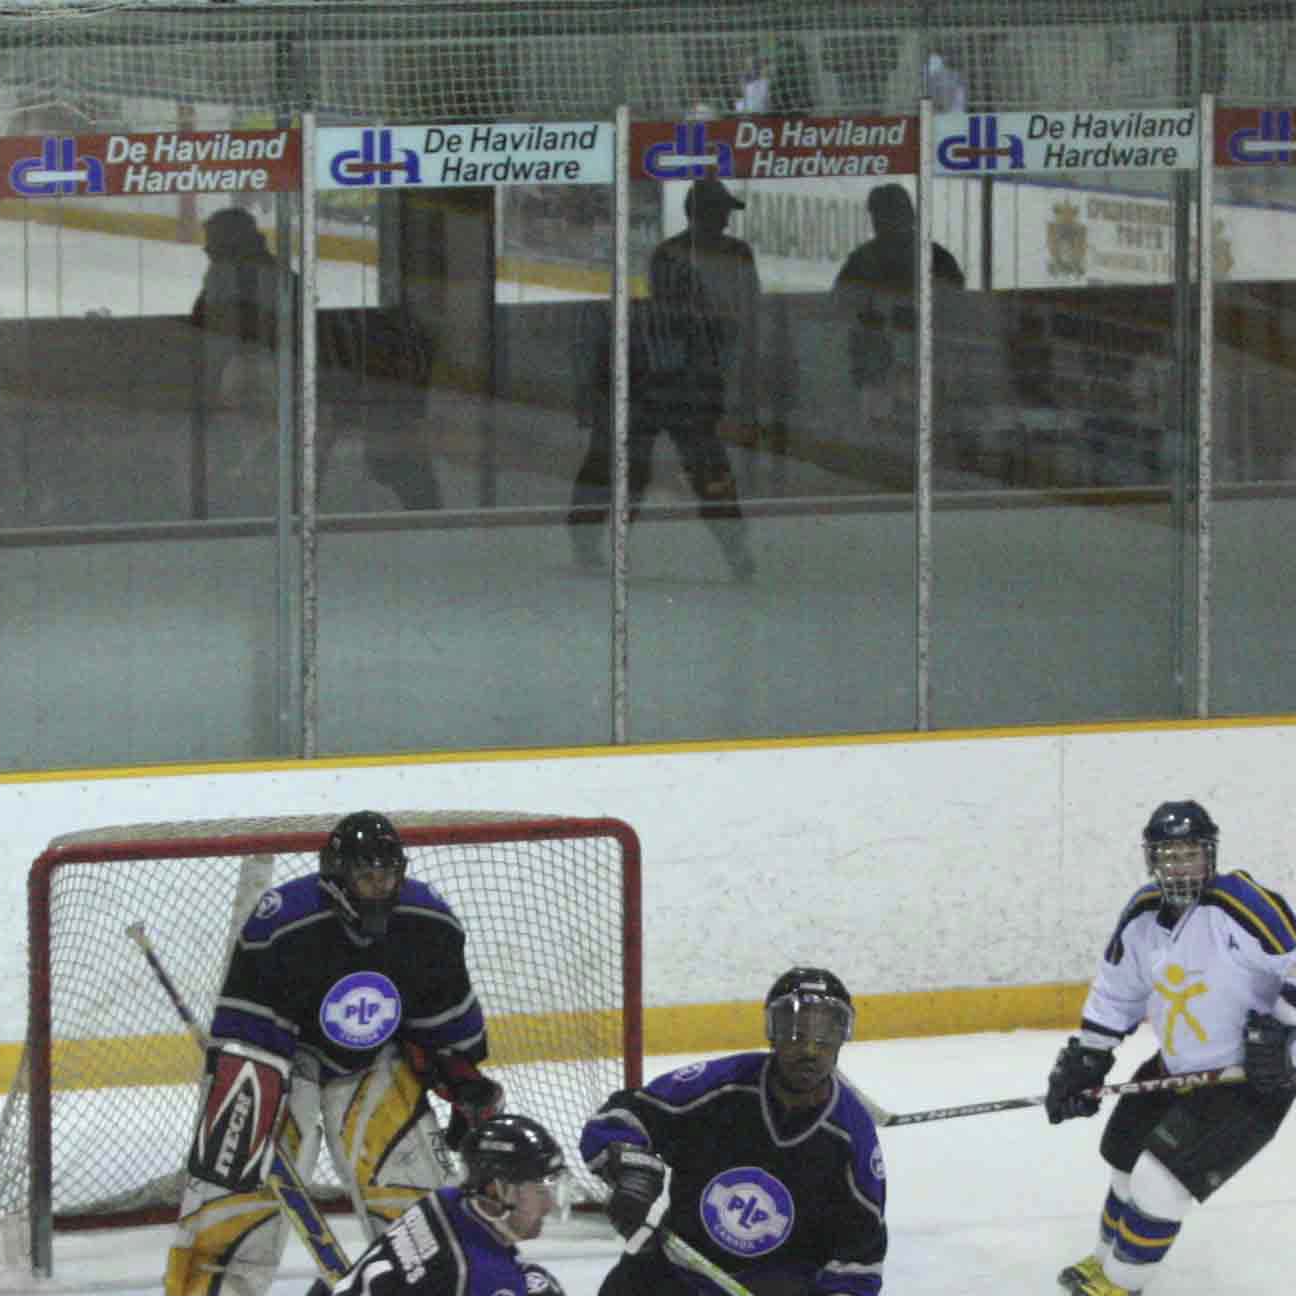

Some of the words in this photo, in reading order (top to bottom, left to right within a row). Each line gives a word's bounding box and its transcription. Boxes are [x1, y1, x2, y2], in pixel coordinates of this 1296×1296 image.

[424, 128, 462, 154] De
[469, 124, 599, 153] Haviland
[735, 121, 774, 149] De
[780, 119, 908, 147] Haviland
[1027, 114, 1064, 140] De
[1071, 111, 1195, 139] Haviland
[106, 135, 147, 164] De
[153, 132, 287, 163] Haviland
[1043, 143, 1177, 168] Hardware
[440, 157, 581, 183] Hardware
[751, 150, 890, 177] Hardware
[122, 165, 268, 193] Hardware
